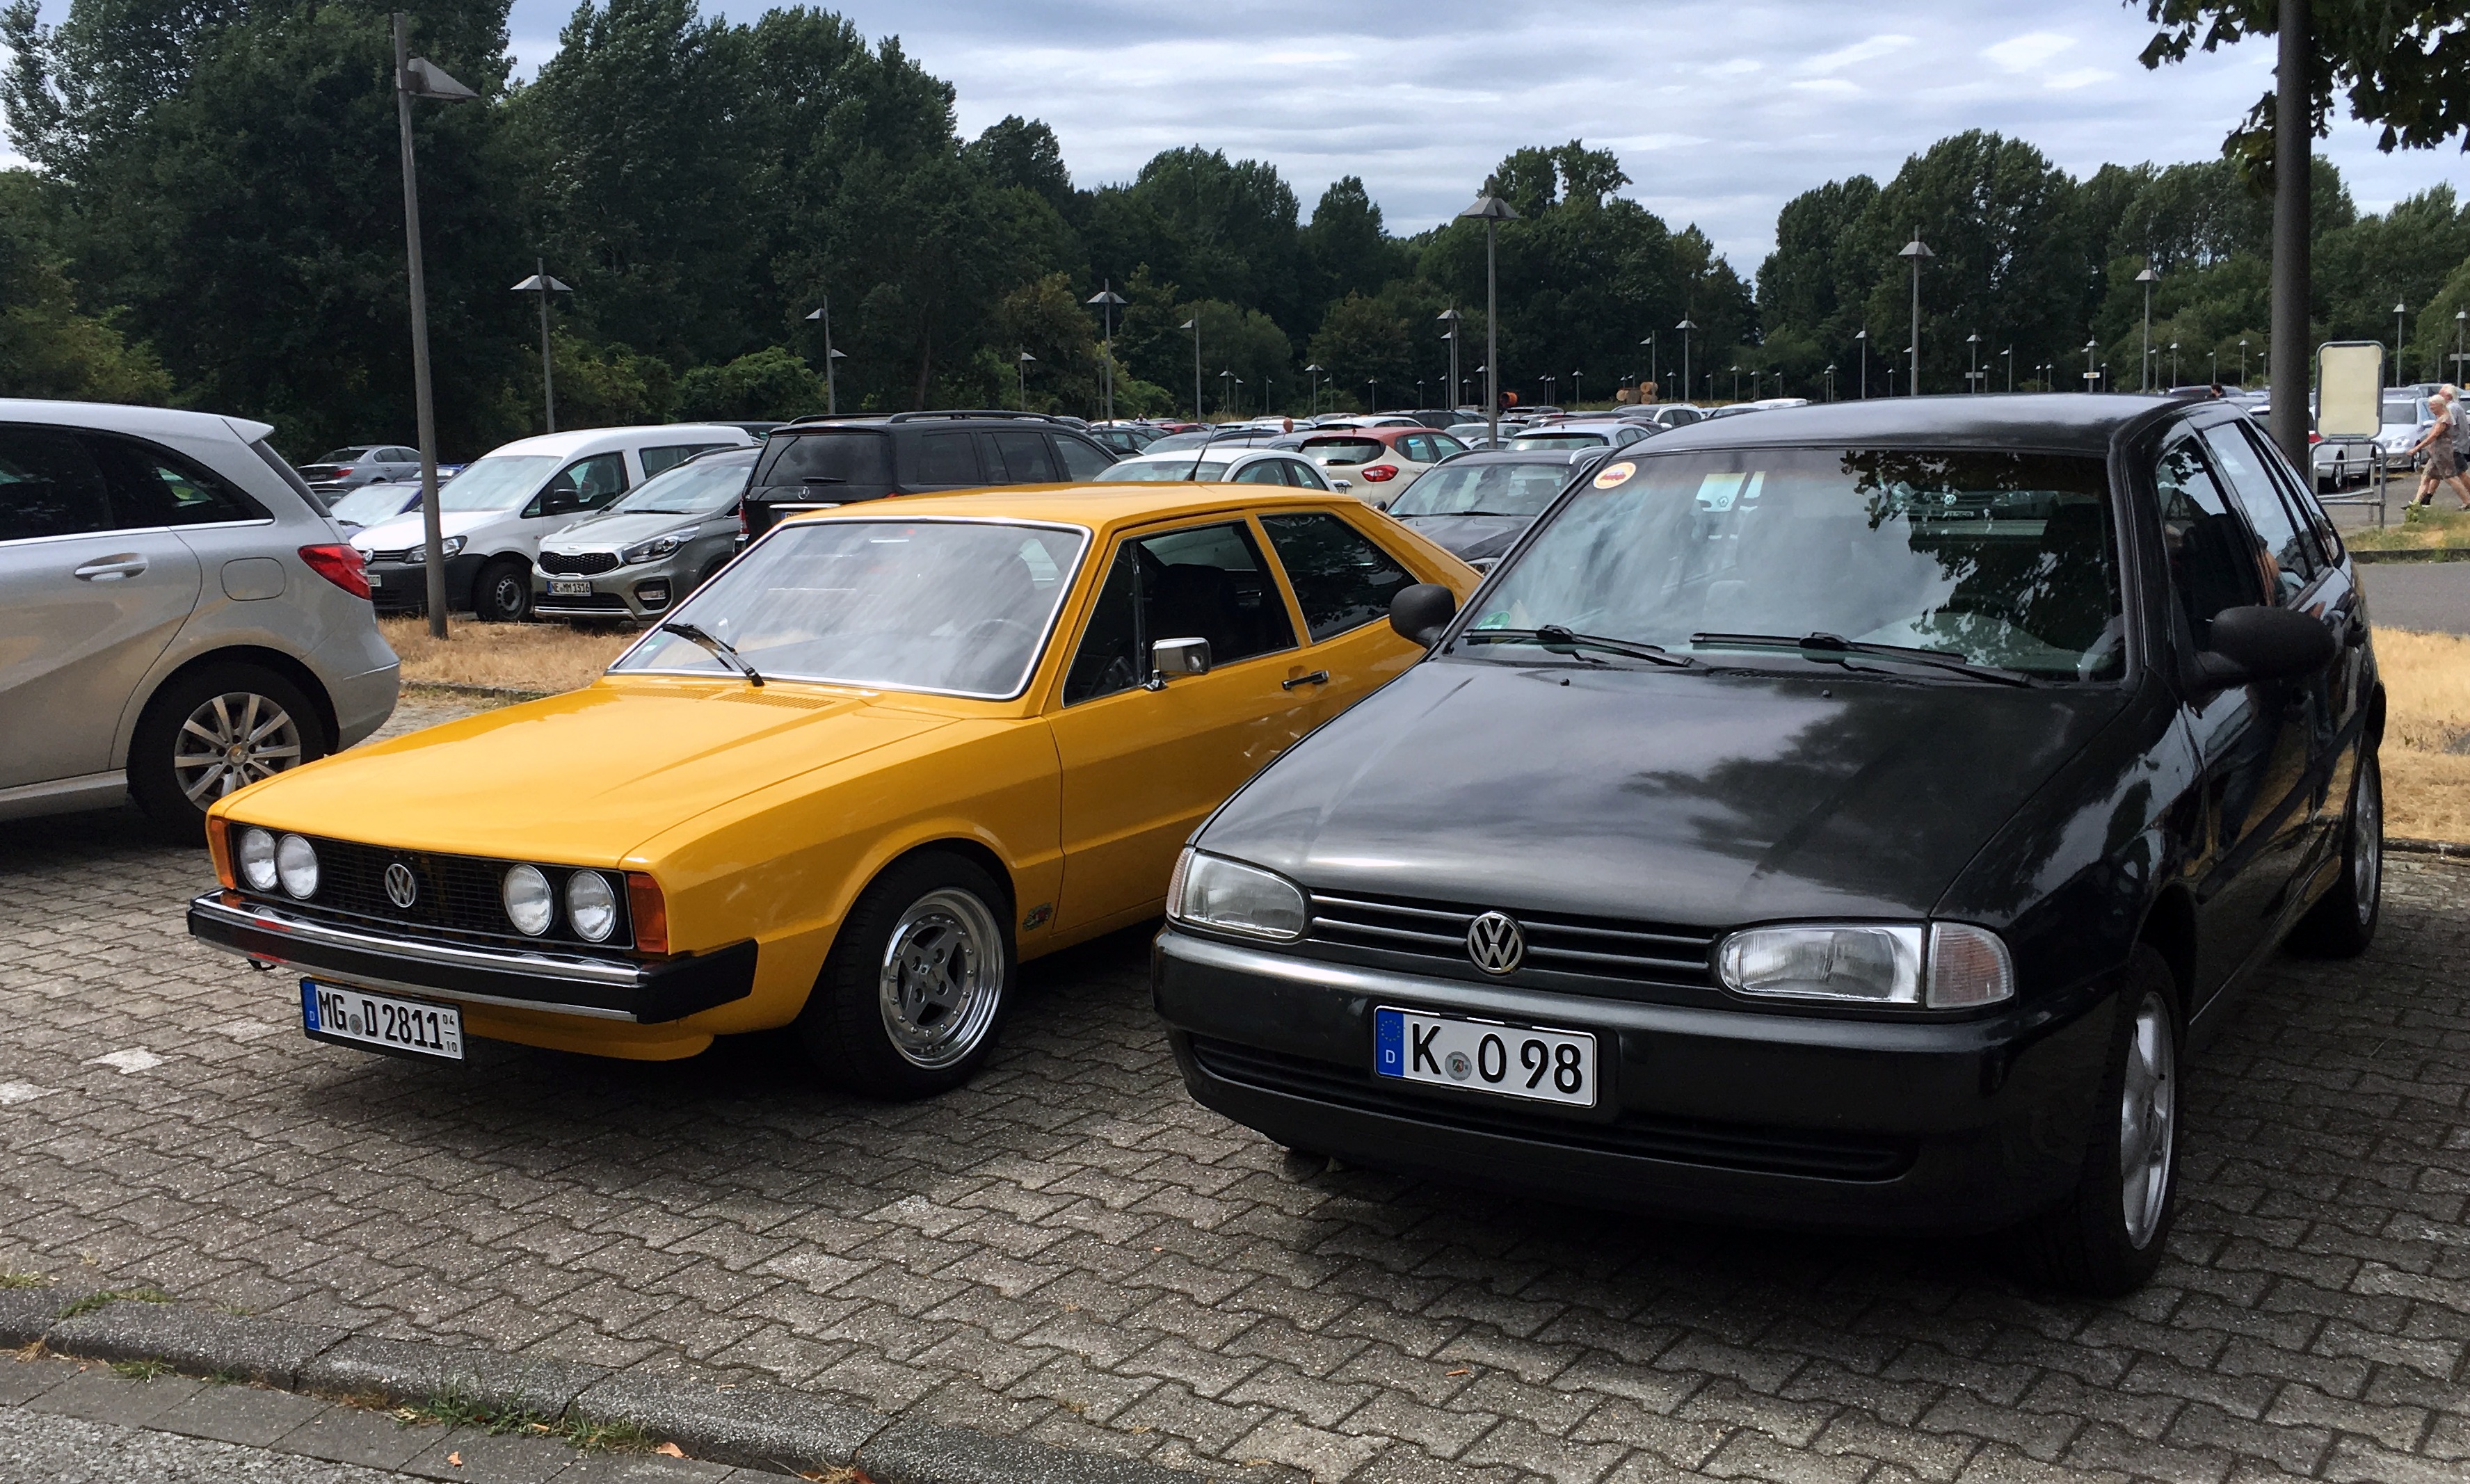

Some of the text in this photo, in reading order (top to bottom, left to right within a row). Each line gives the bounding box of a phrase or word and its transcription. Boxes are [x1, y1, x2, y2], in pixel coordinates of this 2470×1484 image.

[572, 583, 590, 592] 1316
[1467, 912, 1523, 974] VW
[318, 990, 443, 1051] MG D 2811
[442, 1014, 454, 1026] 04
[447, 1040, 457, 1053] 10
[1386, 1049, 1395, 1064] D
[1412, 1023, 1441, 1075] K
[1521, 1039, 1582, 1095] 98
